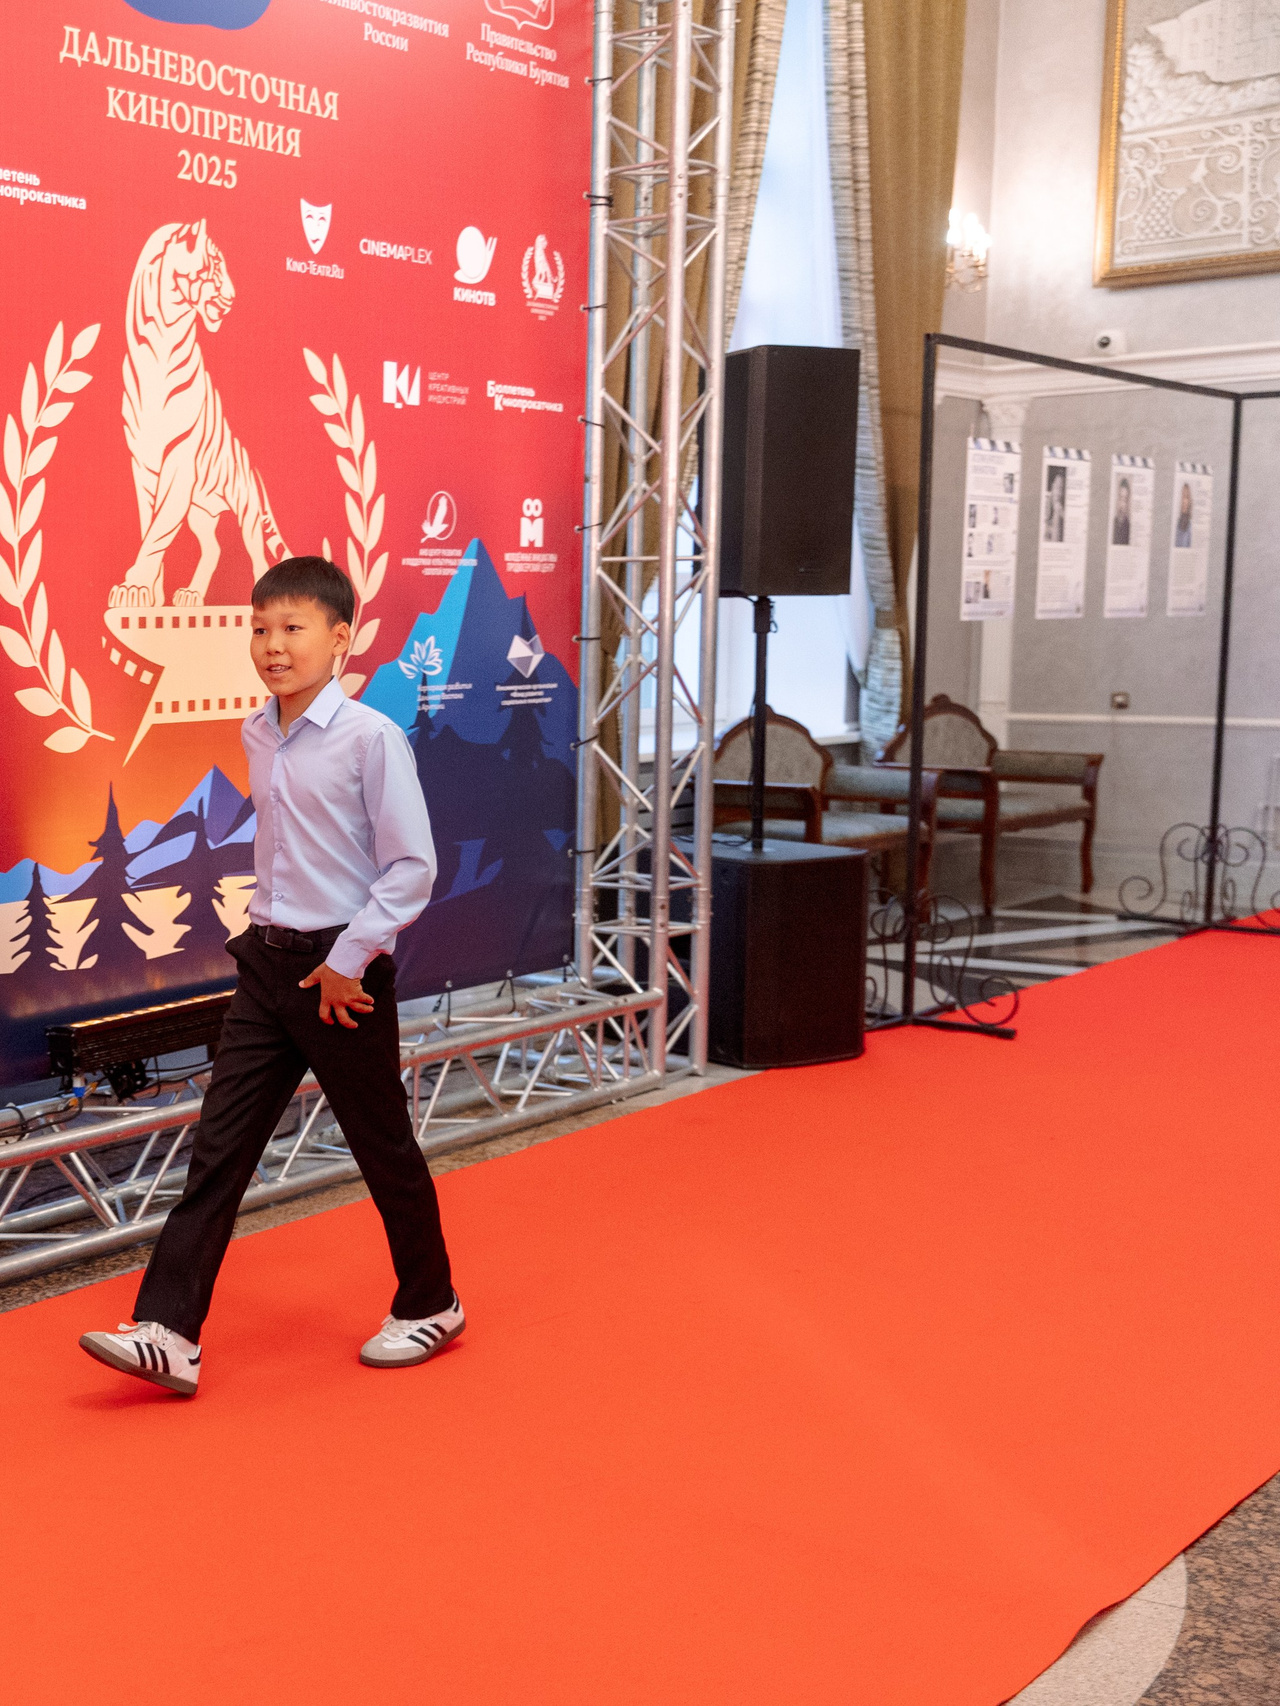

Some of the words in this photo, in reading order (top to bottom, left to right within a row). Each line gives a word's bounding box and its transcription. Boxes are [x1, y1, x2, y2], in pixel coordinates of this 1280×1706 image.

[363, 22, 409, 52] России
[480, 23, 557, 62] Правительство
[59, 25, 340, 121] ДАЛЬНЕВОСТОЧНАЯ
[466, 42, 528, 76] Республики
[529, 61, 570, 88] Бурятия
[105, 86, 302, 158] КИНОПРЕМИЯ
[176, 149, 239, 189] 2025
[359, 238, 433, 265] CINEMAPLEX
[453, 286, 496, 306] КИНОТВ
